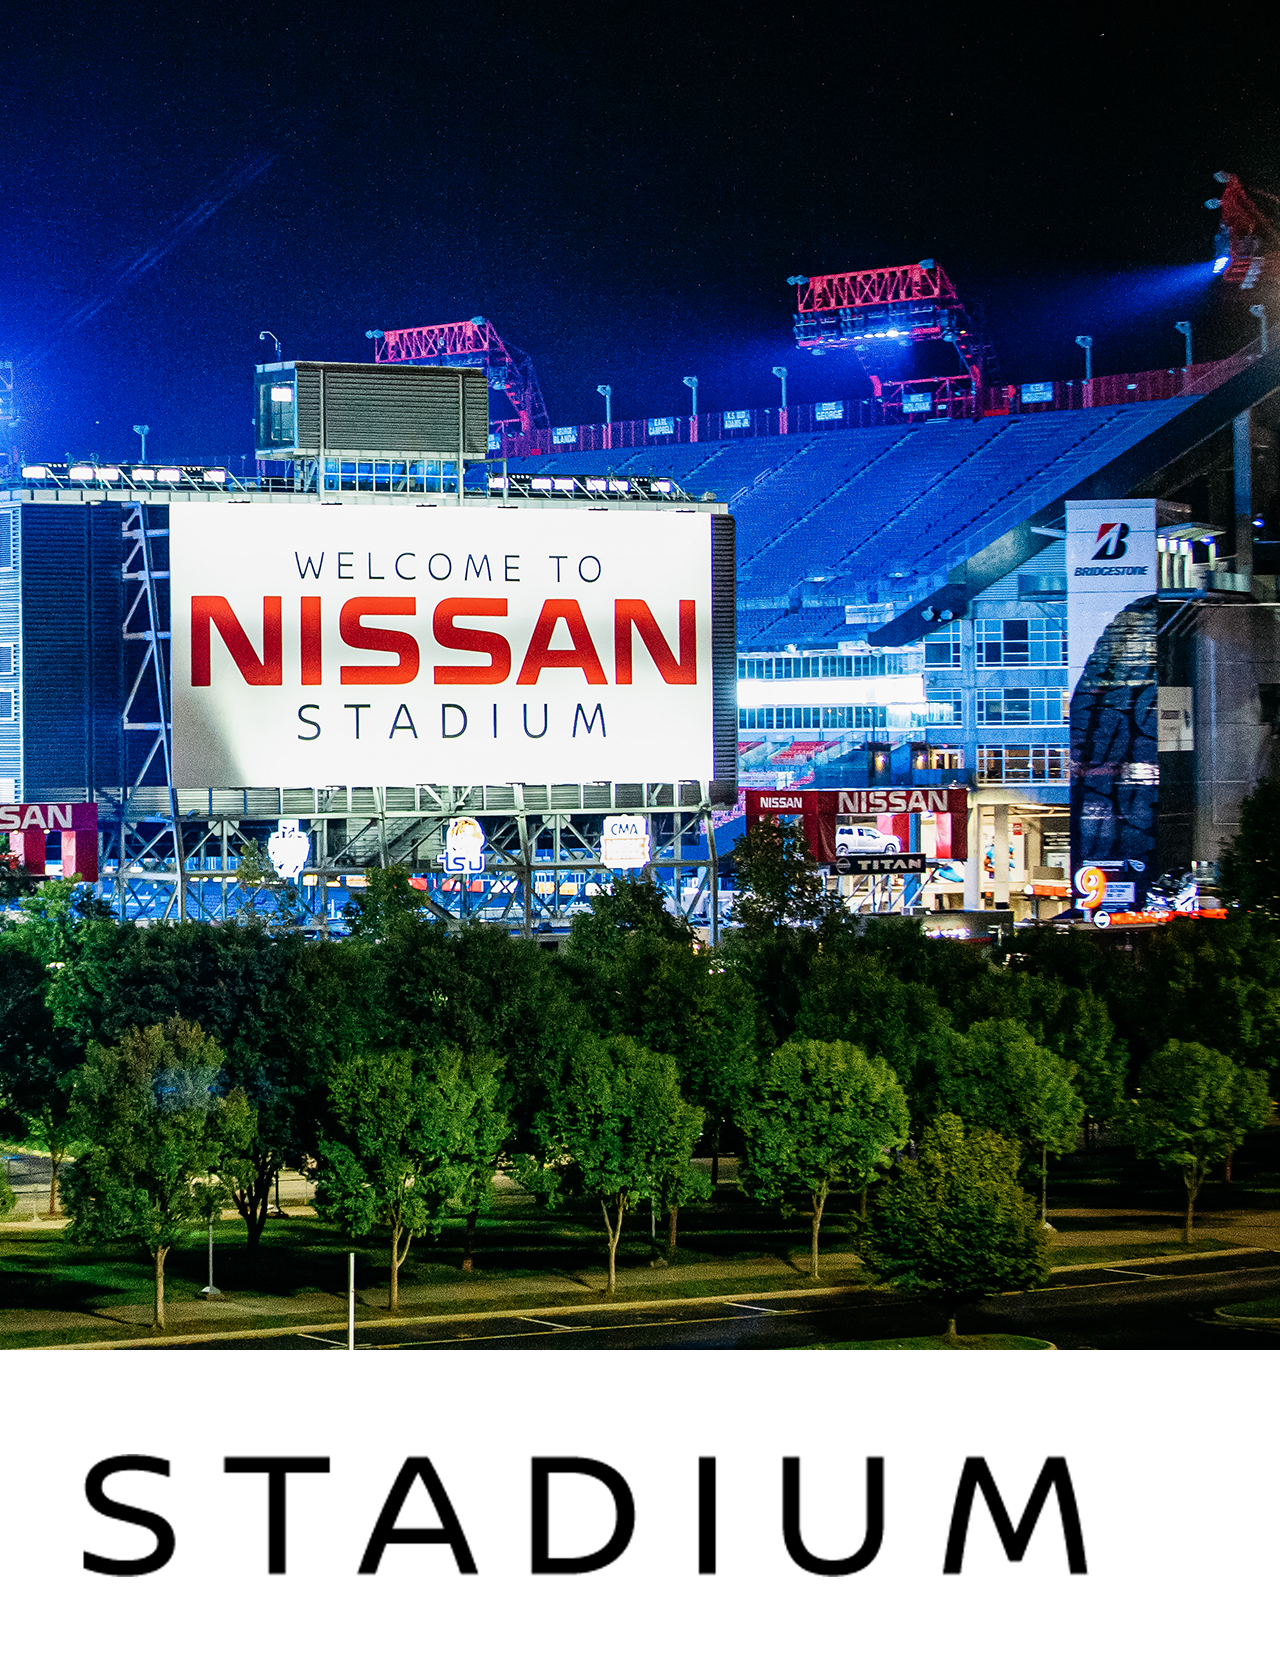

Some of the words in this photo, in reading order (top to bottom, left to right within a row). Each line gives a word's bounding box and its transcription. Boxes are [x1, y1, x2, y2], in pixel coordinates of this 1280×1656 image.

[295, 551, 521, 582] WELCOME
[549, 555, 602, 583] TO
[1074, 566, 1149, 577] BRIDGESTONE
[191, 595, 697, 687] NISSAN
[297, 703, 607, 740] STADIUM
[760, 797, 803, 809] NISSAN
[838, 791, 949, 813] NISSAN
[610, 823, 639, 836] CMA
[857, 859, 923, 871] TITAN
[1074, 865, 1108, 911] 9
